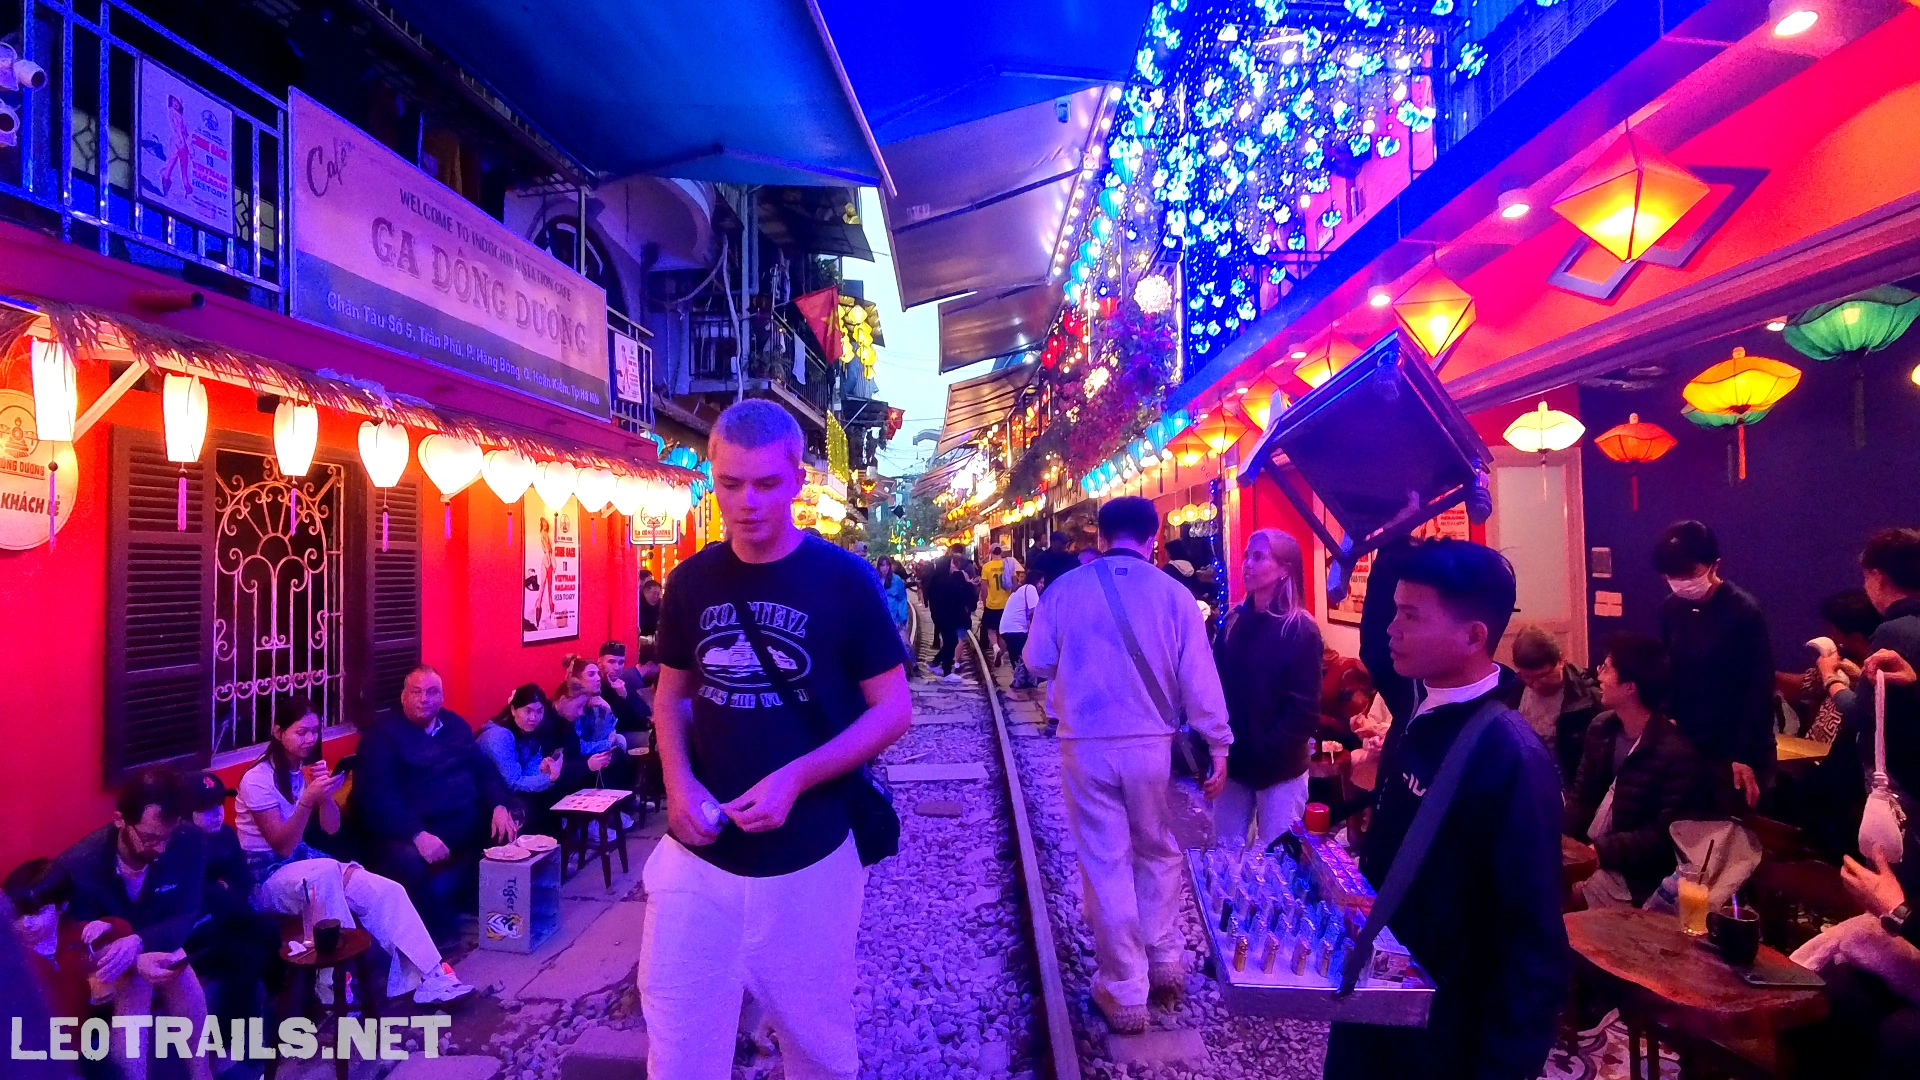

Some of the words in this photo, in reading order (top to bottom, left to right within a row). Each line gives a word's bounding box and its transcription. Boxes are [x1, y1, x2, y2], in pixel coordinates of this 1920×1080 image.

[371, 217, 420, 280] GA
[400, 187, 454, 233] WELCOME
[456, 221, 469, 243] TO
[472, 232, 520, 273] INDOCHINA
[521, 263, 554, 291] STATION
[405, 322, 416, 342] 5,
[1, 490, 45, 514] KHÁCH
[502, 877, 518, 912] Tiger
